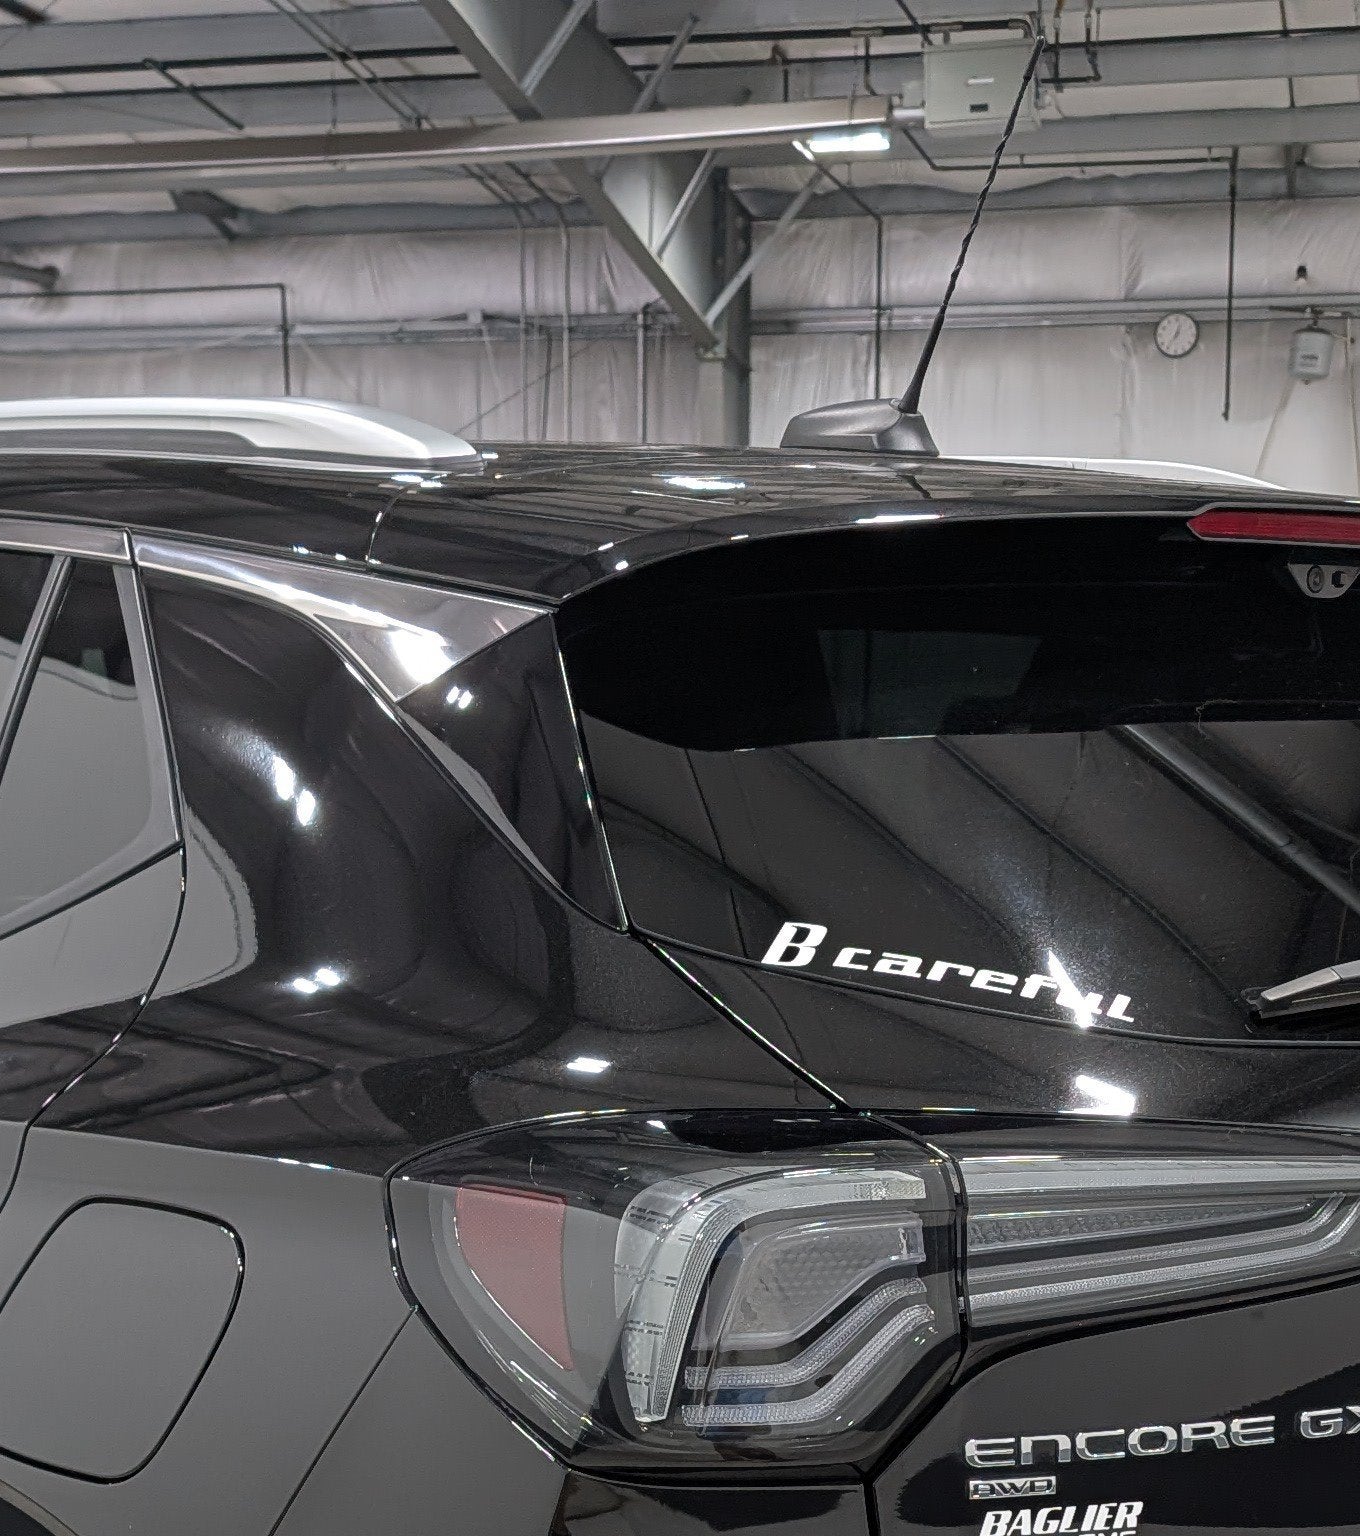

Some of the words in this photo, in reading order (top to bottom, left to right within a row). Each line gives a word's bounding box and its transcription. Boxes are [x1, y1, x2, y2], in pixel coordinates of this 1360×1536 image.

[760, 921, 828, 967] B
[964, 1415, 1276, 1469] ENCORE
[972, 1477, 1055, 1497] AWD
